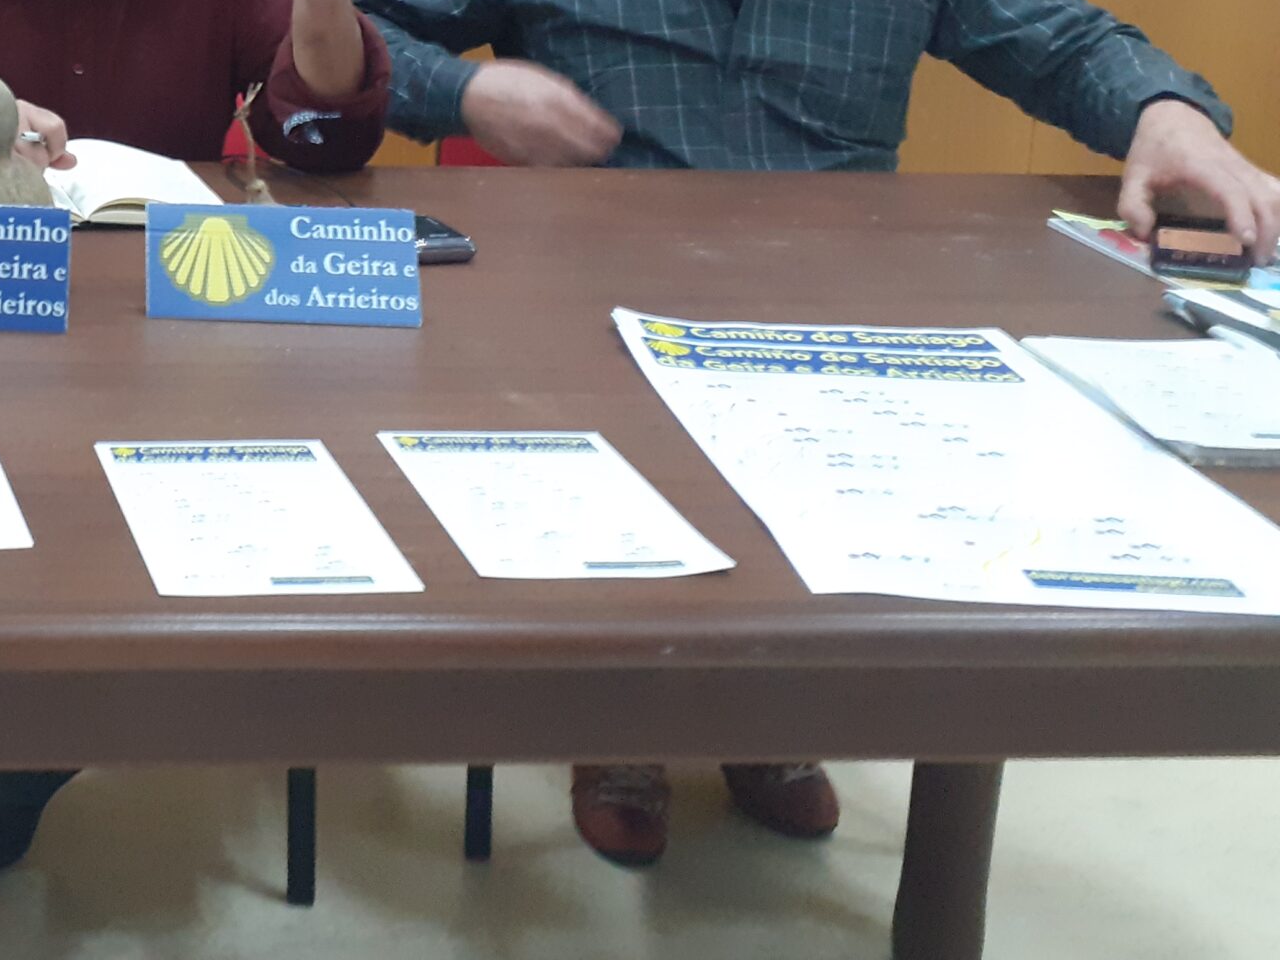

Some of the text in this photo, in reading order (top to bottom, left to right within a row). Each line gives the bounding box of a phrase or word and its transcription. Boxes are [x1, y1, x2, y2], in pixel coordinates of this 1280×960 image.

[290, 215, 414, 243] Caminho
[53, 267, 66, 281] e
[290, 252, 416, 277] da Geira e
[264, 286, 419, 311] dos Arrieiros
[810, 330, 848, 343] de
[852, 331, 986, 348] Santiago
[703, 358, 787, 373] Geira
[820, 348, 858, 363] de
[863, 352, 1002, 370] Santiago
